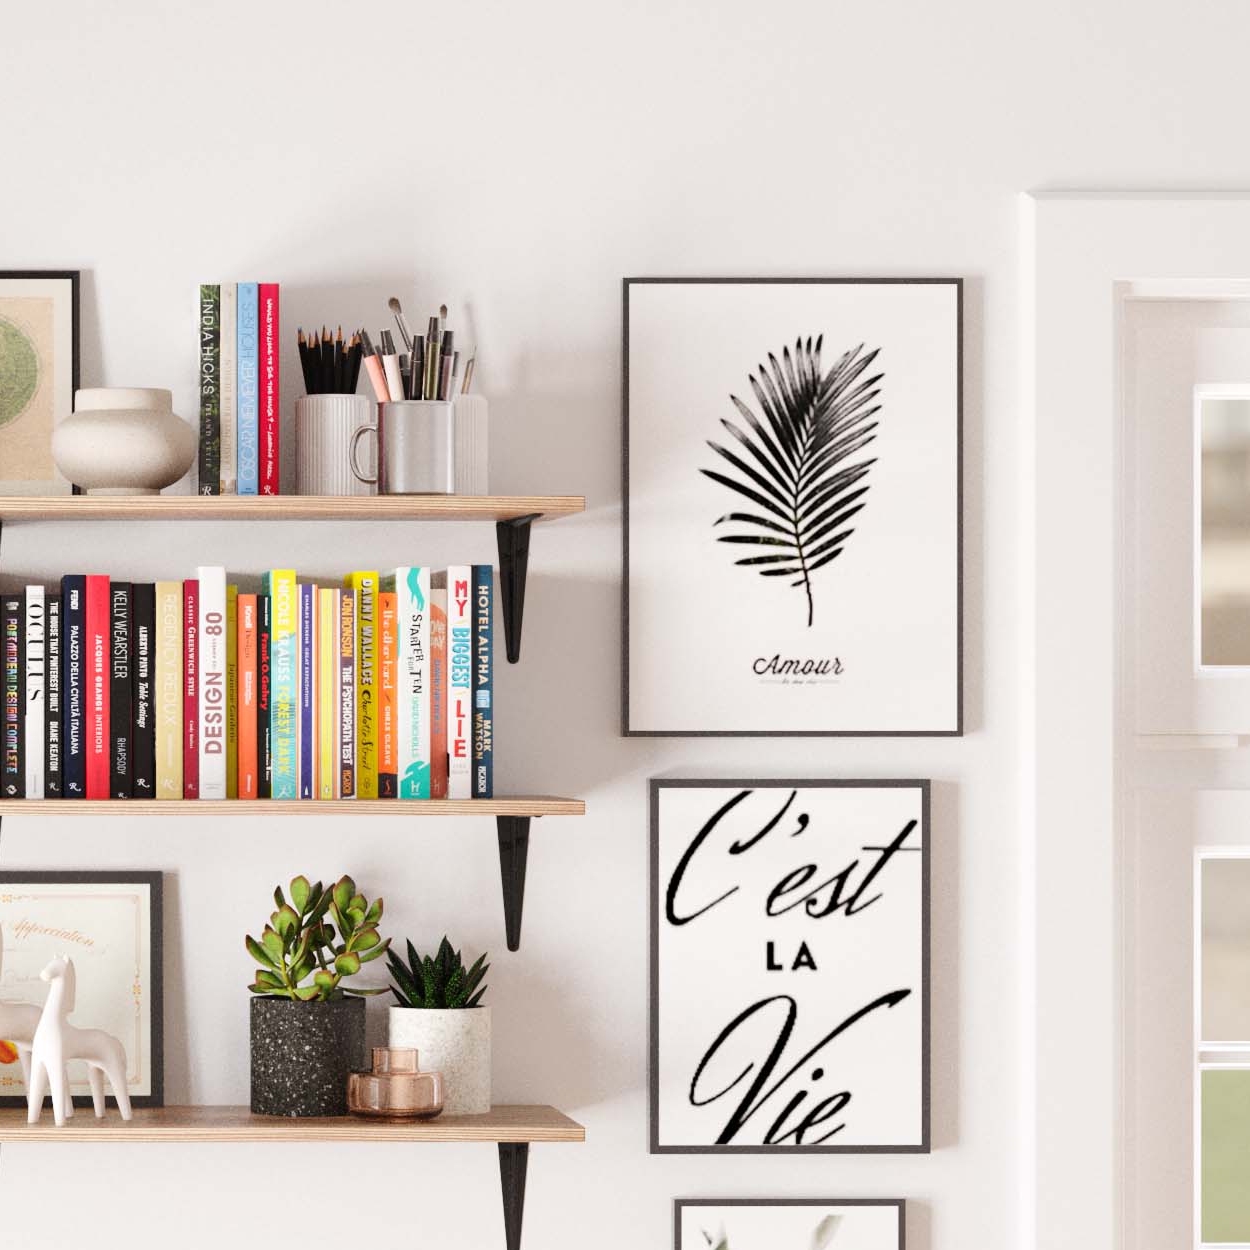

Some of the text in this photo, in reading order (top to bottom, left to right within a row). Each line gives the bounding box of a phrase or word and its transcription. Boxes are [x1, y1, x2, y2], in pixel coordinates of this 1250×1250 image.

[202, 299, 214, 394] INDIA HICKS
[241, 303, 255, 478] OSCAR NIEMEYER HOUSES
[205, 612, 222, 636] 80
[244, 605, 253, 628] Knoll
[455, 580, 468, 617] MY
[6, 618, 18, 683] POSTMODERN
[28, 603, 43, 702] OCULUS
[114, 590, 128, 679] KELLY WEARSTLER
[139, 625, 148, 678] ALBERTO PINTO
[163, 593, 177, 667] REGENCY
[188, 626, 197, 674] GREENWICH
[260, 633, 269, 663] Frank
[383, 610, 393, 689] the other hand
[409, 614, 424, 694] STARTER TEN
[452, 627, 470, 688] BIGGEST
[478, 585, 489, 685] HOTEL ALPHA
[49, 602, 59, 771] THE HOUSE THAT PINTEREST BUILT DIANE KEATON
[70, 589, 81, 755] FENDI PALAZZO DELLA CIVILTÀ ITALIANA
[95, 634, 103, 754] JACQUES GRANGE INTERIORS
[260, 675, 269, 710] Gehry
[277, 579, 290, 775] NICOLE KRAUSS FOREST DARK
[341, 594, 353, 766] JON RONSON THE PSYCHOPATH TEST
[360, 578, 373, 771] DANNY WALLACE Charlotte Street
[753, 654, 844, 675] Amour
[6, 685, 18, 722] DESIGN
[137, 682, 149, 728] Table Settings
[163, 671, 177, 726] REDUX
[205, 672, 222, 755] DESIGN
[454, 699, 466, 757] LIE
[6, 723, 18, 773] COMPLETE
[117, 737, 127, 775] RHAPSODY
[475, 712, 484, 760] WATSON
[483, 719, 491, 752] MARK
[478, 766, 487, 793] PICADOR
[666, 790, 921, 926] C'est
[766, 941, 818, 971] LA
[689, 989, 912, 1145] Vie
